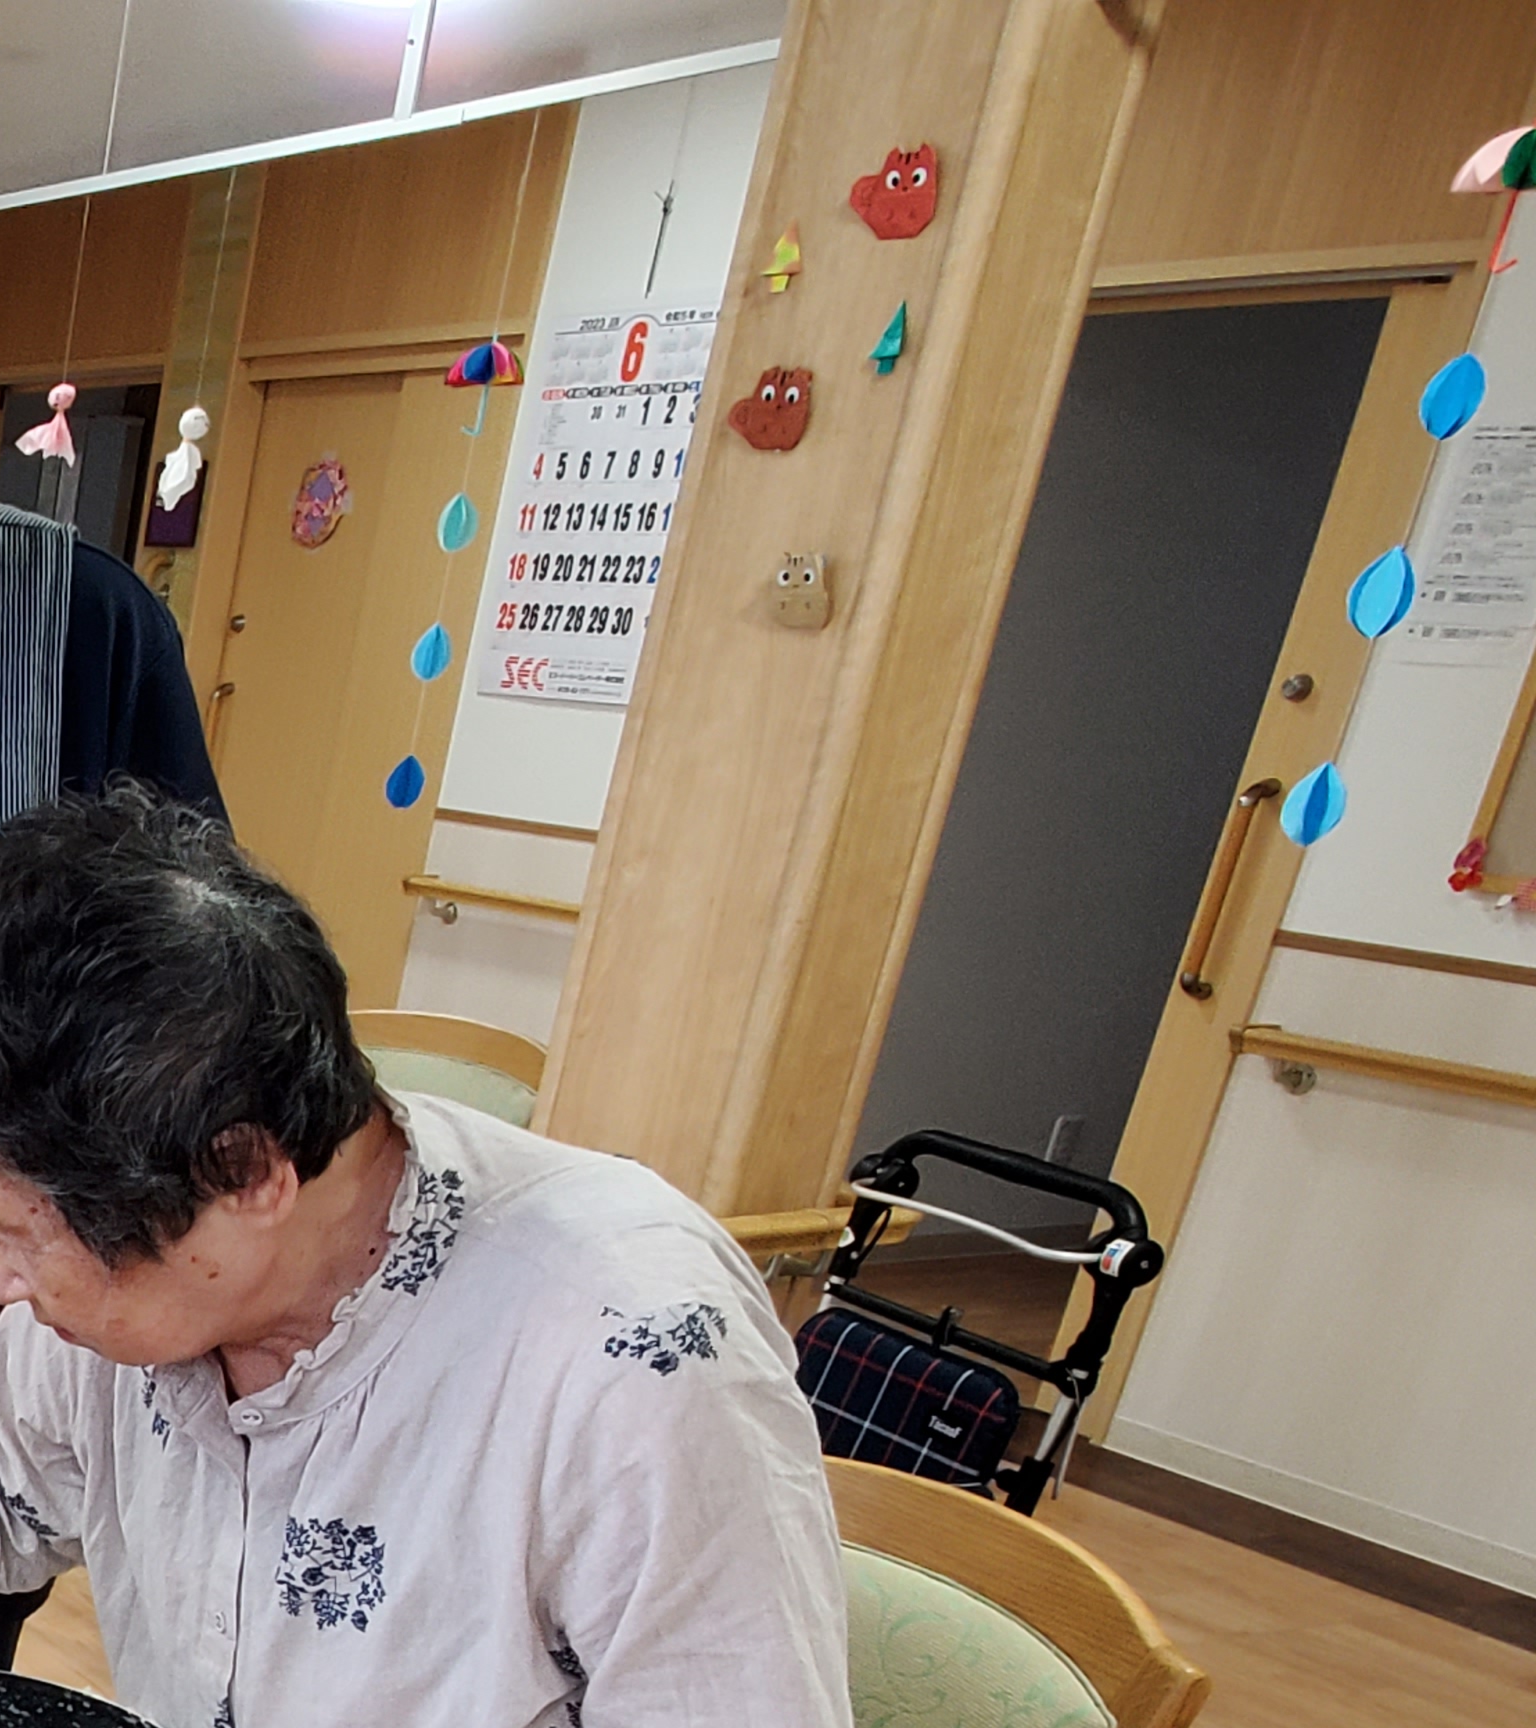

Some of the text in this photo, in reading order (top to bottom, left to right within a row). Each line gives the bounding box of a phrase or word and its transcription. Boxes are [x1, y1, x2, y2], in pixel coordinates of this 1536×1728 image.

[620, 321, 648, 383] 6
[591, 405, 602, 420] 30
[616, 405, 626, 419] 31
[641, 396, 652, 425] 1
[663, 395, 677, 424] 2
[533, 452, 544, 480] 4
[555, 452, 568, 480] 5
[579, 451, 591, 479] 6
[603, 451, 617, 479] 7
[628, 449, 640, 478] 8
[652, 449, 664, 478] 9
[520, 503, 537, 531] 11
[542, 503, 561, 531] 12
[565, 503, 585, 531] 13
[589, 503, 609, 531] 14
[613, 503, 633, 531] 15
[637, 502, 657, 531] 16
[508, 553, 527, 581] 18
[532, 553, 550, 581] 19
[552, 554, 574, 582] 20
[576, 554, 597, 582] 21
[599, 555, 621, 583] 22
[622, 555, 646, 584] 23
[496, 602, 517, 630] 25
[519, 603, 540, 631] 26
[541, 604, 564, 632] 27
[563, 605, 586, 632] 28
[586, 606, 609, 634] 29
[611, 607, 634, 635] 30
[500, 655, 549, 692] SEC
